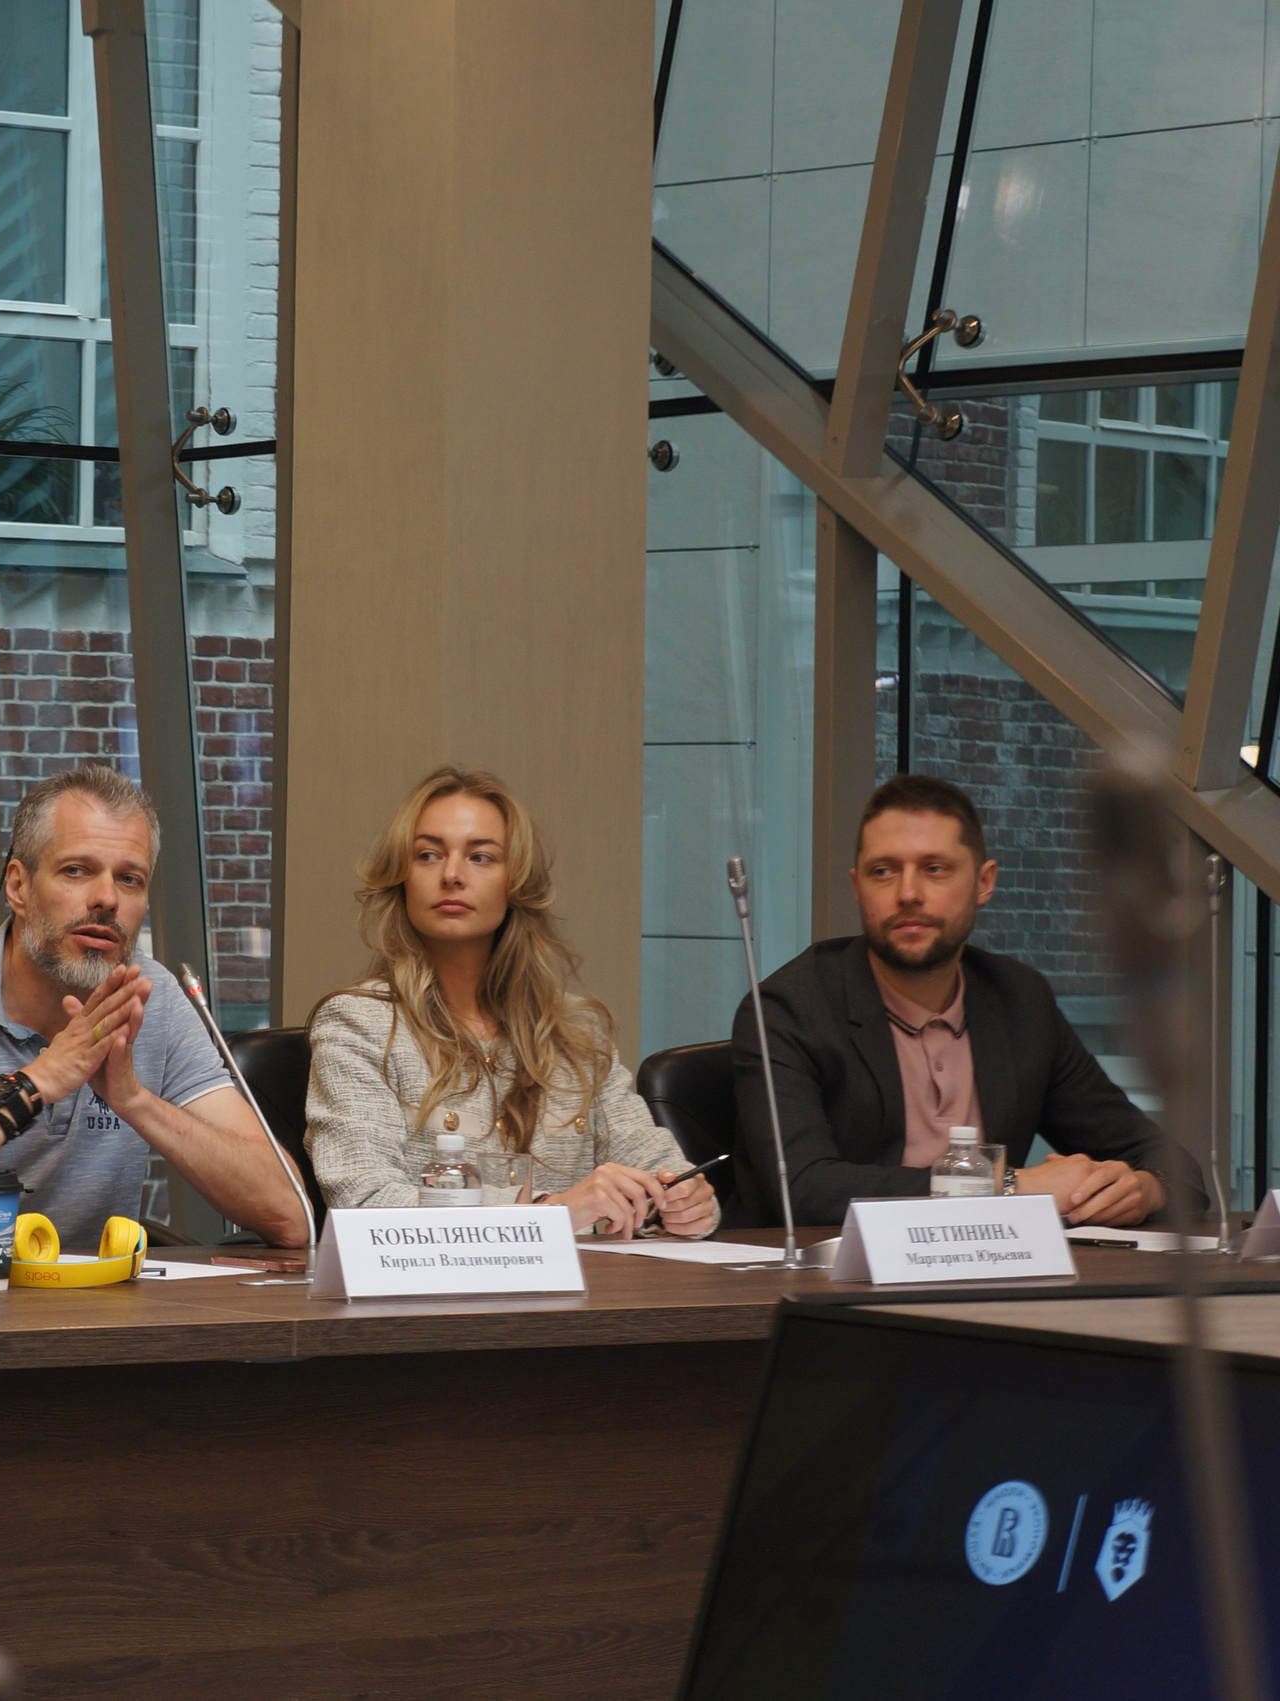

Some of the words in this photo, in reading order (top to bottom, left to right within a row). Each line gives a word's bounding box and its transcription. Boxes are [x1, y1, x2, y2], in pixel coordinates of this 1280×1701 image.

[87, 1116, 121, 1130] USPA
[369, 1221, 544, 1246] КОБЫЛЯНСКИЙ
[906, 1223, 1020, 1245] ЩЕТИНИНА
[379, 1254, 436, 1271] Кирилл
[439, 1253, 544, 1270] Владимирович
[905, 1252, 974, 1268] Маргарита
[975, 1249, 1033, 1265] Юрьевна
[25, 1271, 61, 1284] beats
